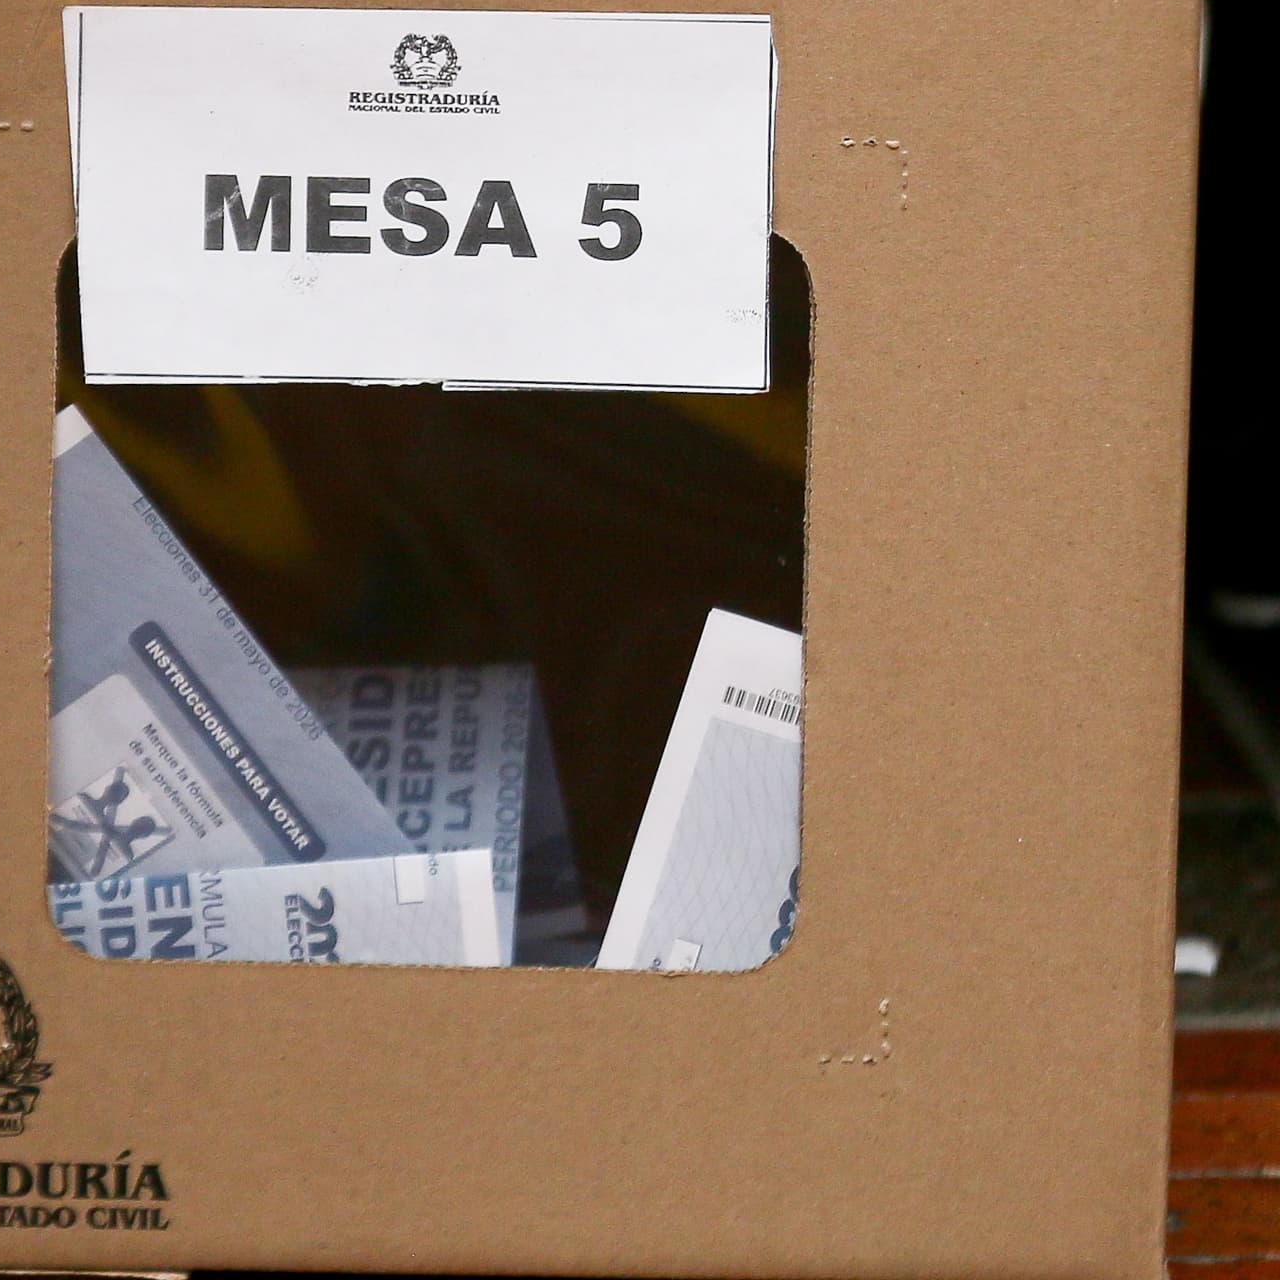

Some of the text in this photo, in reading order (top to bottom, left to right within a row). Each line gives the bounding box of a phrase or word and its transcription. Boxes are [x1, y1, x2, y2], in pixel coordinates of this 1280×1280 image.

[348, 90, 501, 107] REGISTRADURÍA
[348, 104, 501, 115] NACIONAL DEL ESTADO CIVIL
[204, 174, 643, 262] MESA 5
[132, 495, 202, 585] Elecciones
[216, 606, 237, 631] de
[233, 629, 271, 676] mayo
[270, 673, 289, 699] de
[128, 738, 207, 840] de su preferencia
[142, 722, 224, 830] Marque la fórmula
[144, 638, 310, 851] INSTRUCCIONES PARA VOTAR
[443, 784, 474, 832] LA
[492, 761, 522, 893] PERIODO
[84, 1205, 171, 1231] CIVIL
